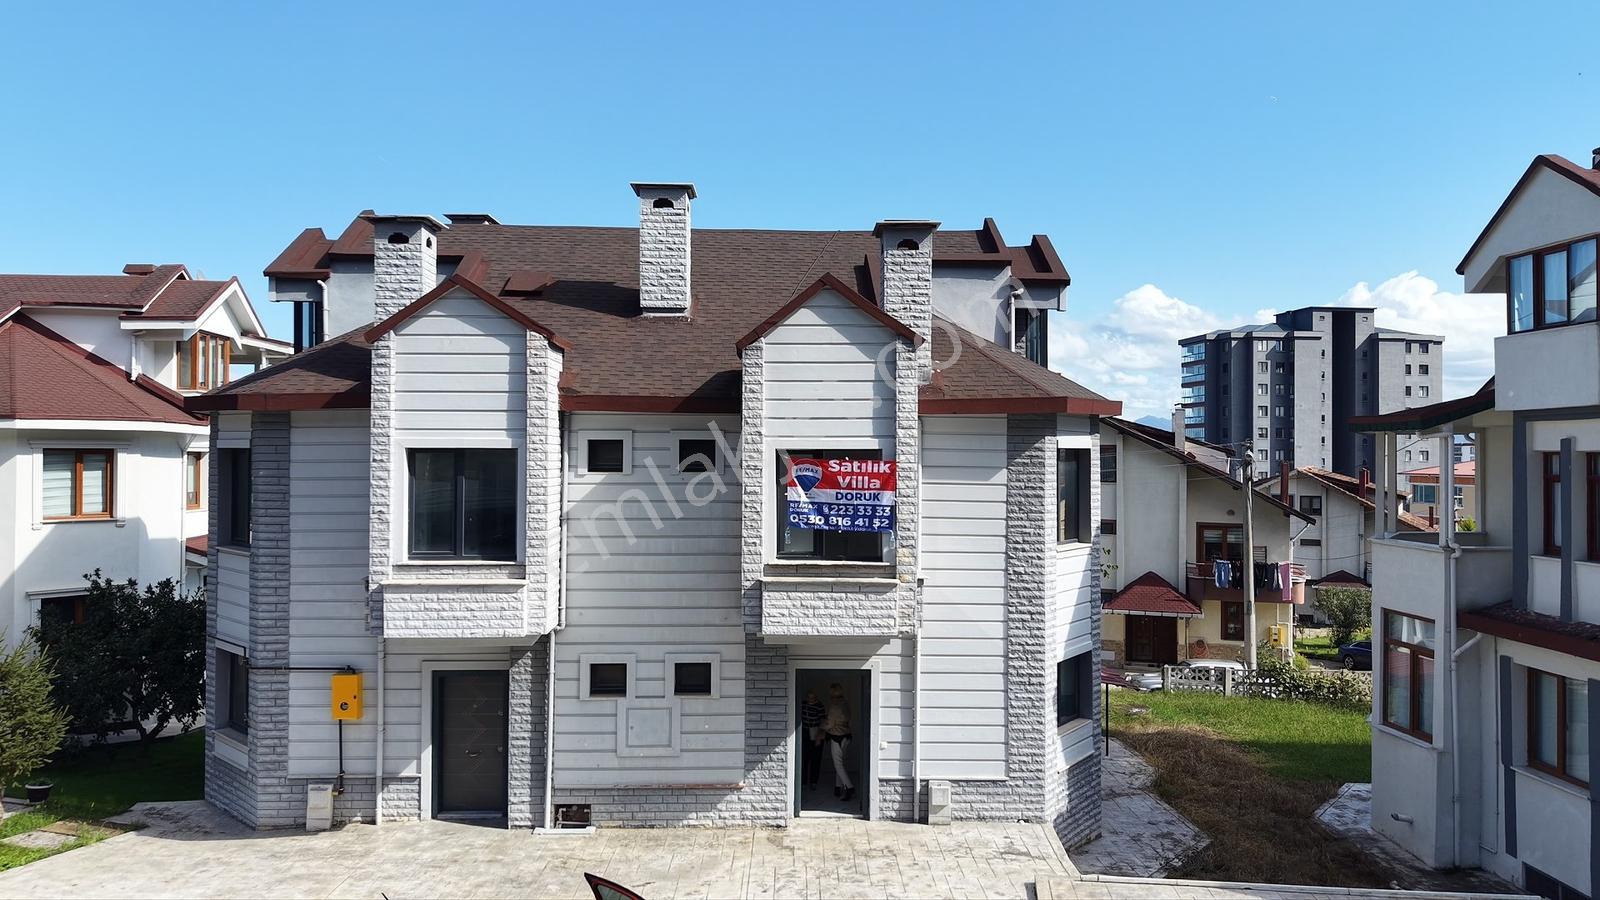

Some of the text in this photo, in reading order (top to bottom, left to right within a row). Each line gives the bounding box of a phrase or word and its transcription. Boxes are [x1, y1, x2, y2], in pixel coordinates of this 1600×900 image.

[837, 475, 881, 489] Villa
[835, 491, 881, 502] DORUK
[830, 504, 891, 517] 223 33 33
[790, 514, 825, 524] 0530
[828, 516, 852, 526] 816
[854, 517, 869, 526] 41
[872, 518, 889, 528] 52
